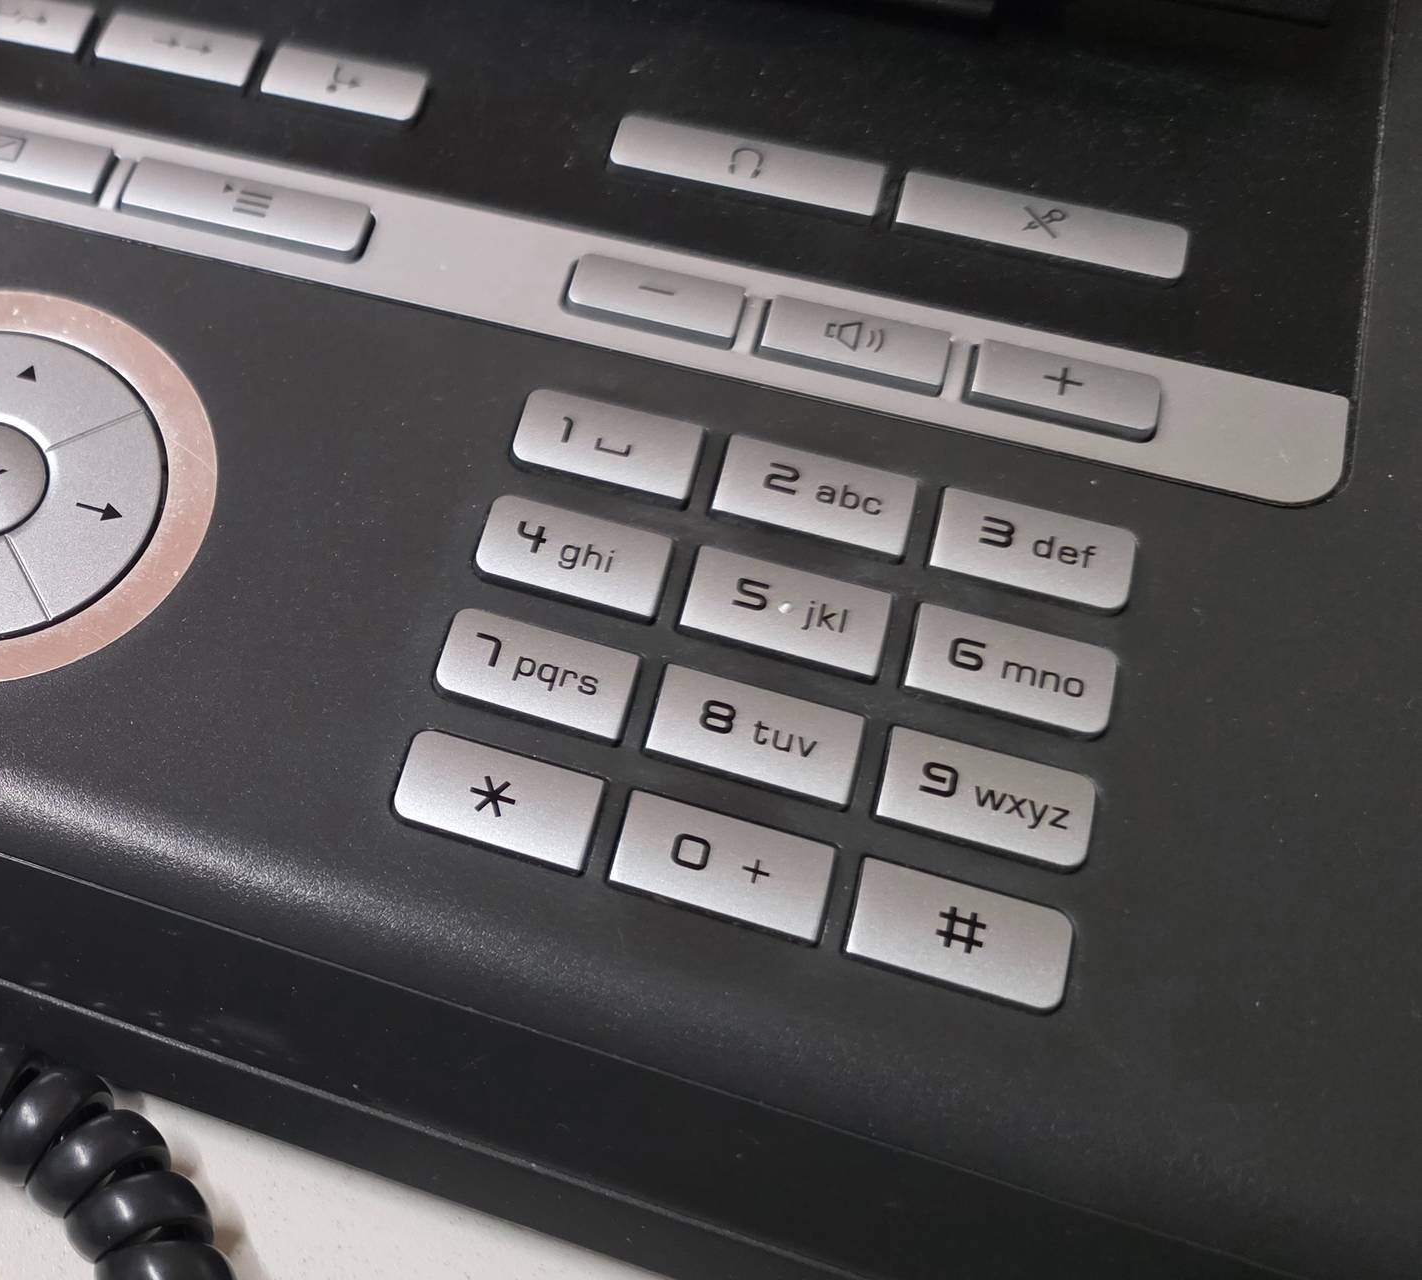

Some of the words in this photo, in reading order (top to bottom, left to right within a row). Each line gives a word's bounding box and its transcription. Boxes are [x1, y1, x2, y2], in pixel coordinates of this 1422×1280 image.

[560, 415, 576, 443] 1
[763, 462, 802, 496] 2
[815, 484, 883, 516] abc
[517, 520, 548, 554] 4
[557, 540, 617, 575] ghi
[978, 515, 1017, 549] 3
[1032, 535, 1098, 569] def
[731, 577, 773, 611] 5
[801, 600, 849, 634] jkl
[475, 631, 503, 668] 7
[511, 655, 600, 696] pqrs
[948, 637, 987, 672] 6
[1001, 660, 1085, 698] mno
[699, 699, 738, 735] 8
[753, 720, 819, 758] tuv
[918, 761, 960, 798] 9
[974, 785, 1071, 831] wxyz
[670, 832, 712, 871] 0
[935, 905, 988, 955] #
